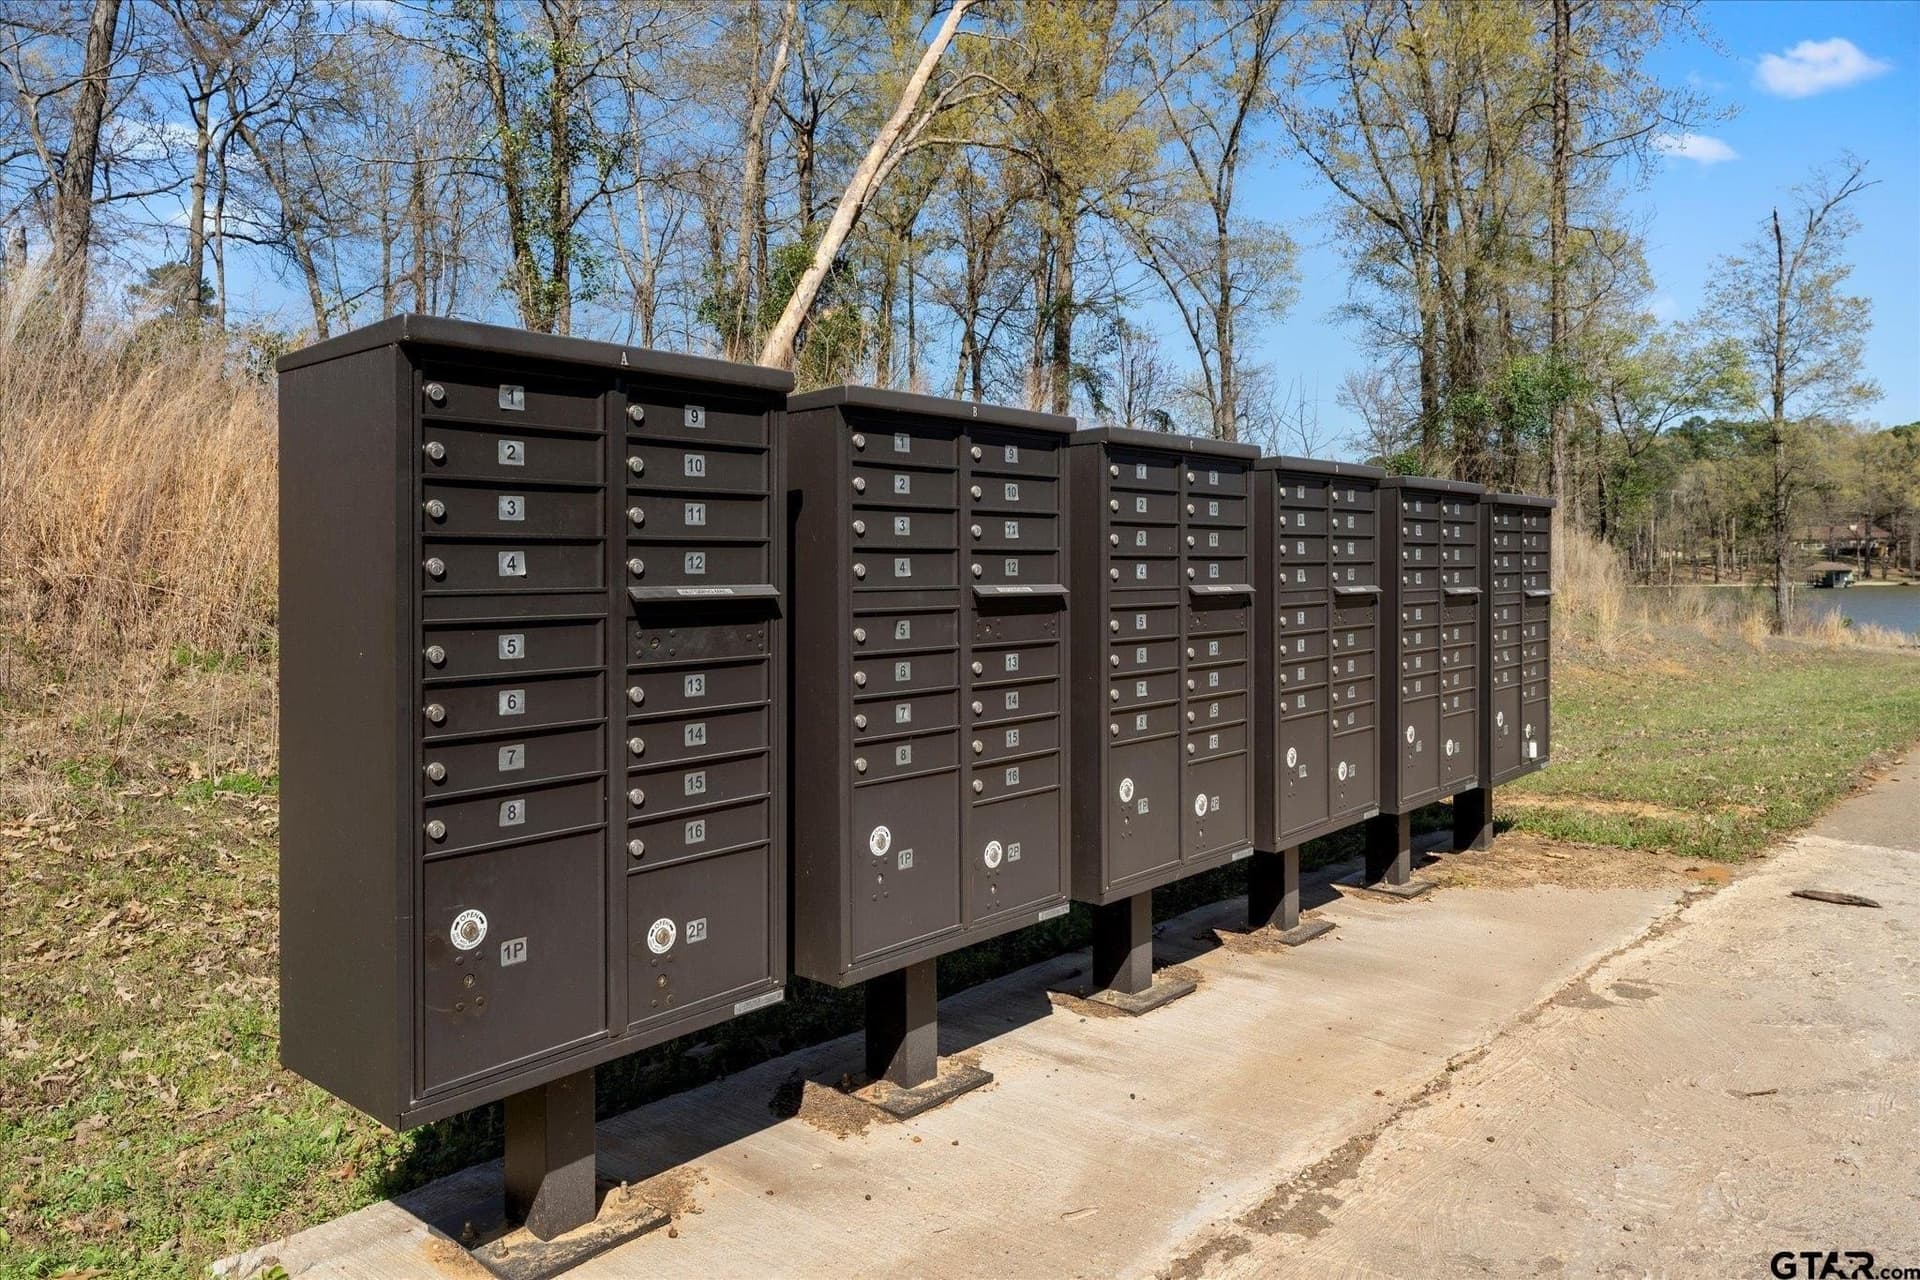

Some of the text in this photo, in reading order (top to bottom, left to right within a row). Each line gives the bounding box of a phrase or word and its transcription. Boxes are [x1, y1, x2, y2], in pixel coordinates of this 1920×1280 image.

[620, 351, 629, 366] A
[507, 389, 514, 405] 1
[691, 409, 699, 424] 9
[972, 406, 978, 417] B
[899, 436, 905, 449] 1
[506, 444, 517, 461] 2
[1008, 448, 1015, 460] 9
[687, 457, 703, 473] 10
[899, 477, 906, 490] 2
[1007, 486, 1017, 498] 10
[506, 499, 517, 517] 3
[688, 506, 702, 521] 11
[899, 519, 906, 532] 3
[1006, 524, 1016, 535] 11
[506, 555, 517, 572] 4
[687, 555, 703, 570] 12
[899, 561, 906, 573] 4
[1007, 561, 1017, 573] 12
[899, 623, 906, 636] 5
[507, 638, 517, 655] 5
[1007, 656, 1018, 668] 13
[900, 665, 907, 678] 6
[687, 677, 703, 693] 13
[507, 694, 517, 710] 6
[1007, 694, 1017, 706] 14
[900, 706, 907, 719] 7
[687, 726, 703, 742] 14
[1008, 731, 1018, 744] 15
[507, 749, 517, 765] 7
[900, 748, 907, 761] 8
[1007, 769, 1018, 782] 16
[687, 775, 703, 791] 15
[507, 804, 517, 821] 8
[687, 823, 703, 839] 16
[899, 851, 912, 865] 1P
[1008, 845, 1020, 859] 2P
[459, 911, 481, 922] OPEN
[655, 919, 671, 930] OPEN
[688, 921, 705, 939] 2P
[503, 941, 524, 961] 1P
